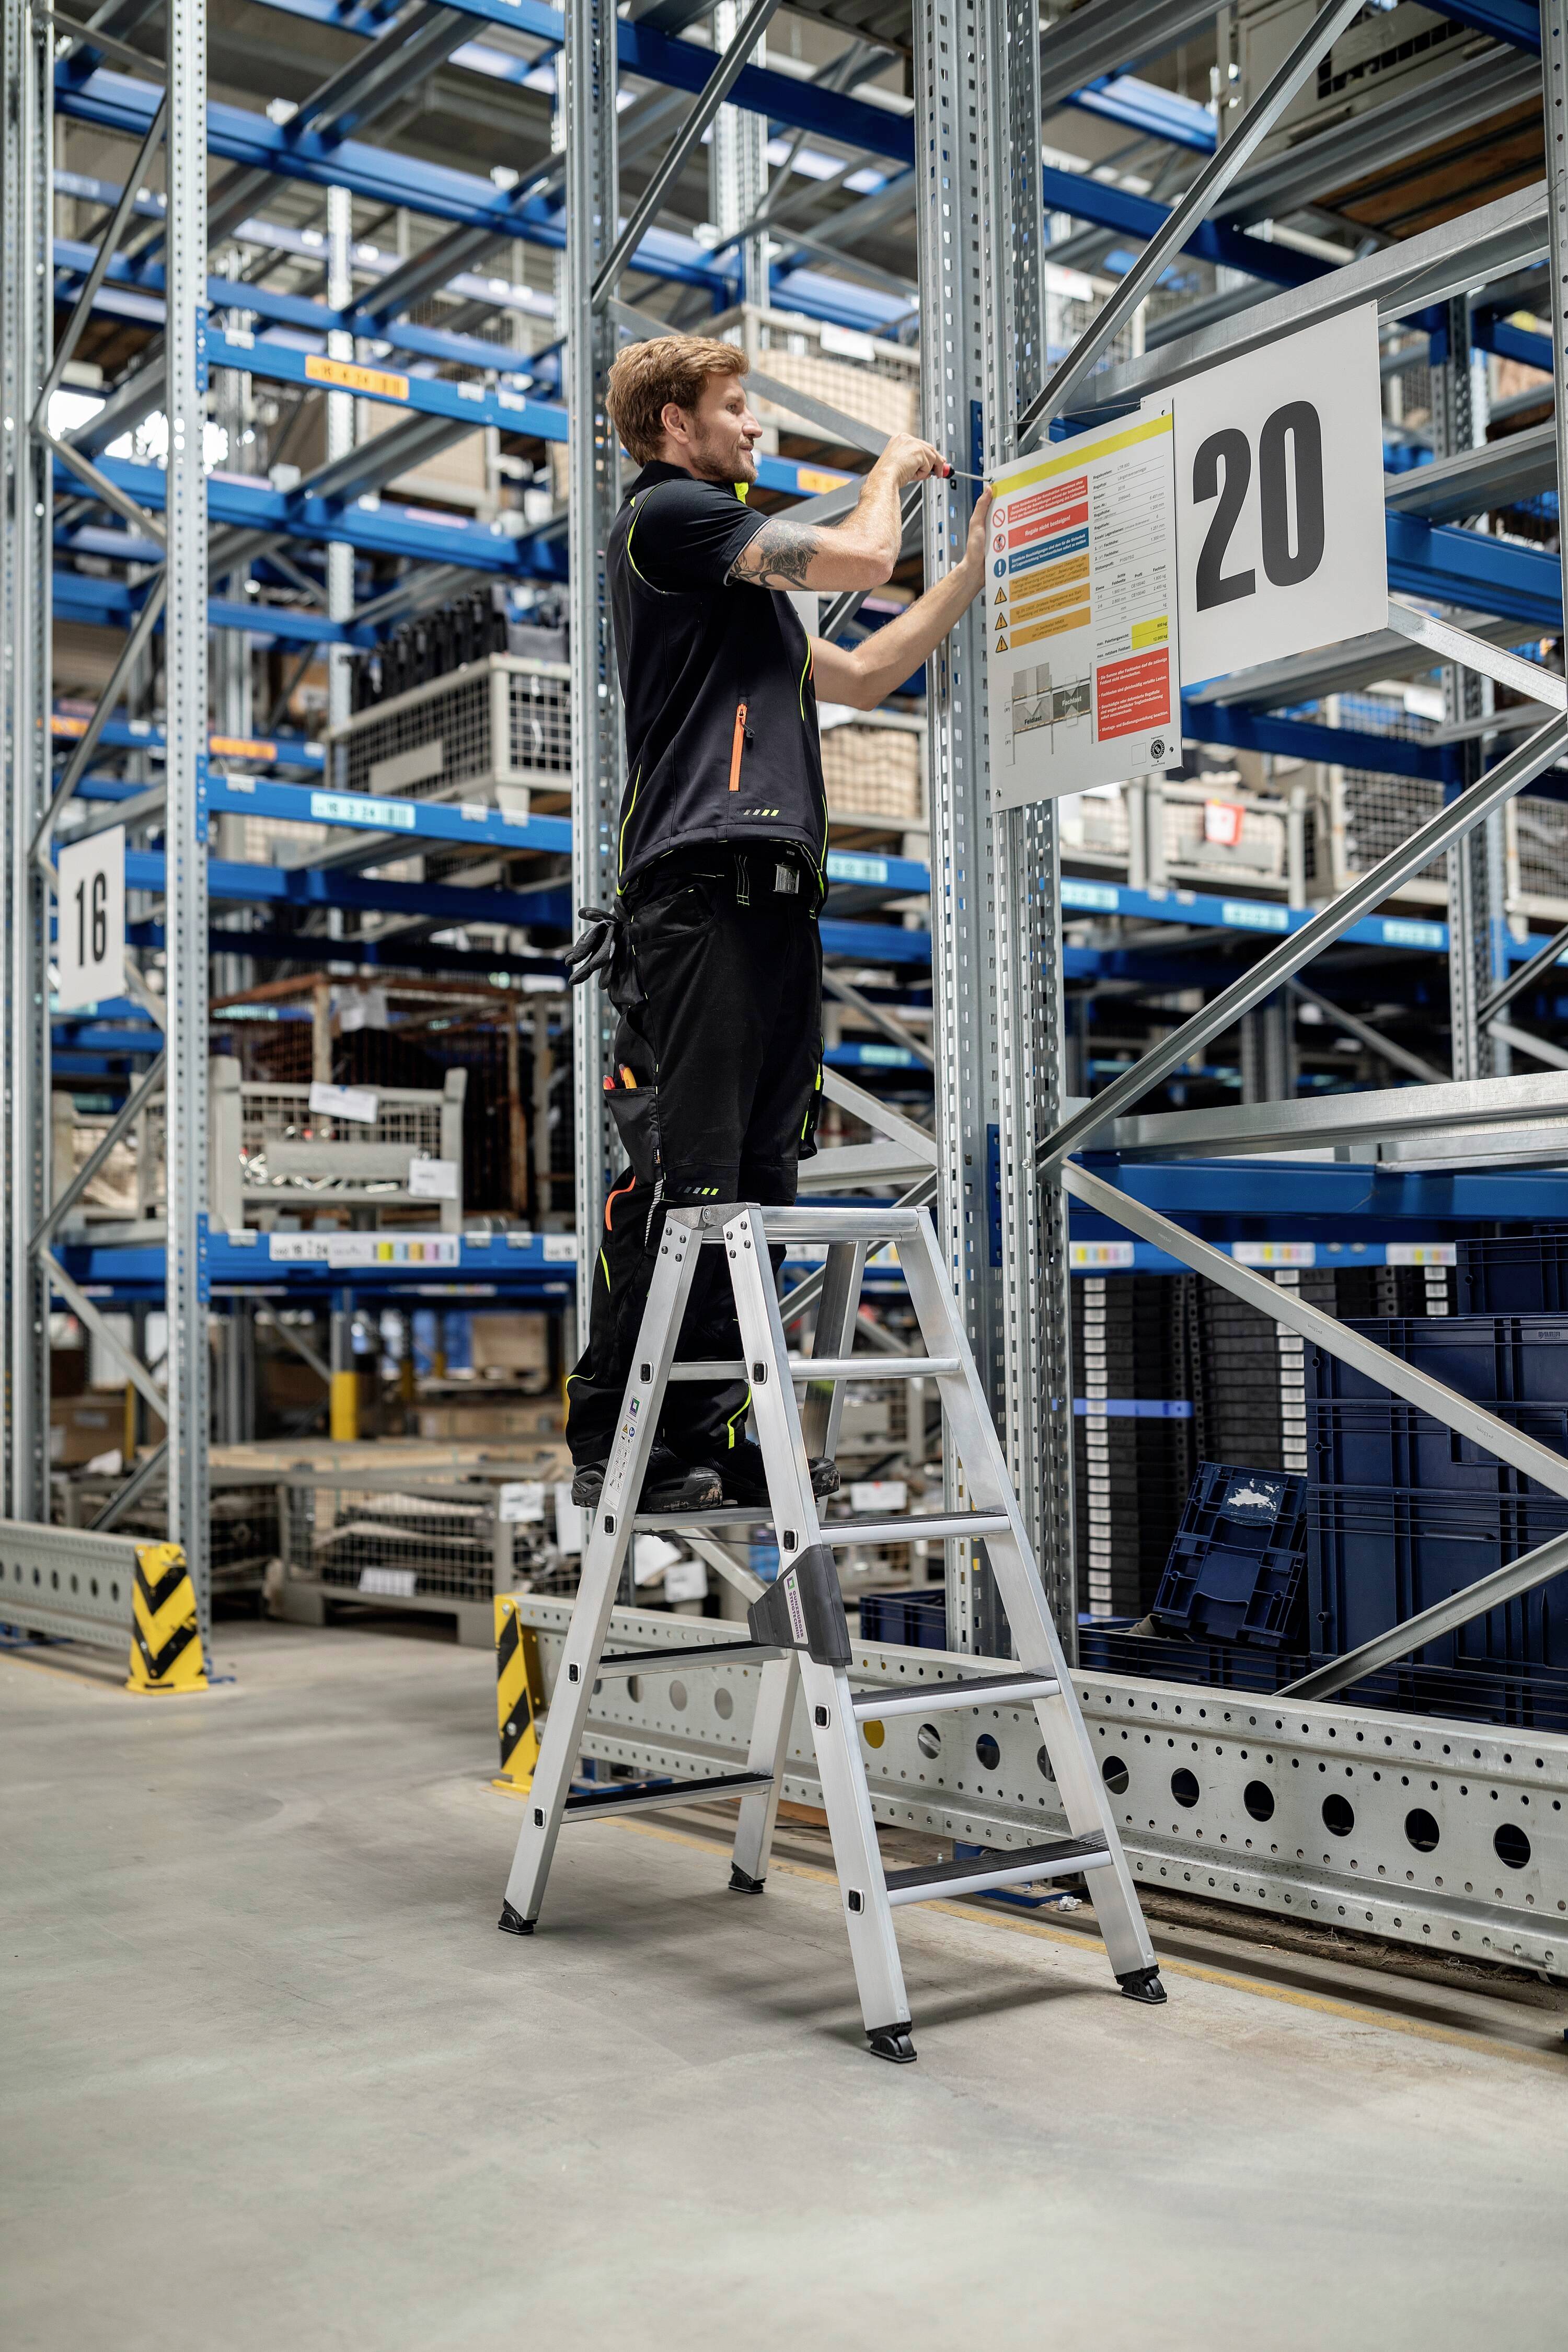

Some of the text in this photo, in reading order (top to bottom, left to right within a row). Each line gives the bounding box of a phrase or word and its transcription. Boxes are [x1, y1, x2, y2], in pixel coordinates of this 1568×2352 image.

[1192, 400, 1325, 613] 20
[1025, 515, 1070, 537] Regale nicht besteigen!
[1124, 664, 1140, 673] Fachlasten
[1062, 696, 1081, 706] Fachlast
[1024, 716, 1042, 725] Feldlast
[76, 872, 106, 966] 16
[789, 1592, 800, 1639] STEIGTECHNIK
